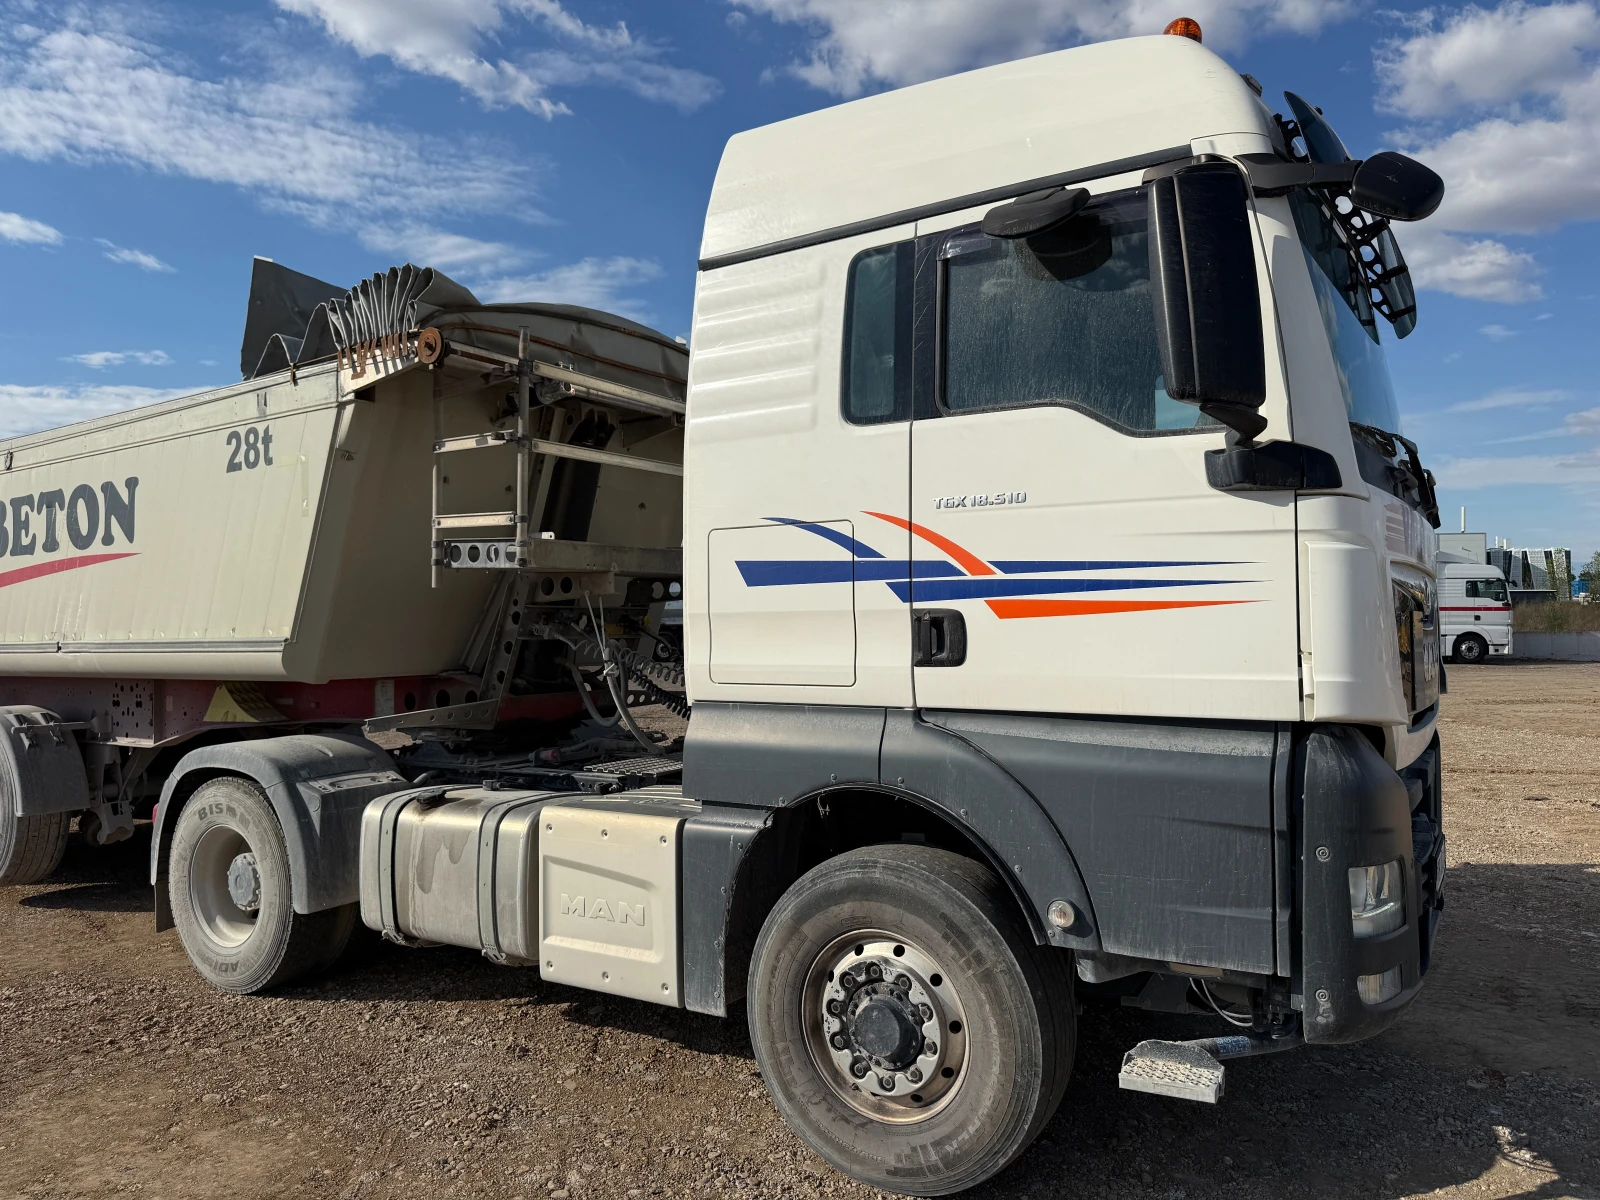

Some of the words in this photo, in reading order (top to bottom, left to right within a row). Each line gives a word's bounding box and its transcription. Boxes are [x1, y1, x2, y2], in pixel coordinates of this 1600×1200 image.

[225, 424, 274, 473] 28t
[933, 495, 967, 509] TGX
[969, 491, 1027, 508] 18.510
[560, 893, 646, 927] MAN
